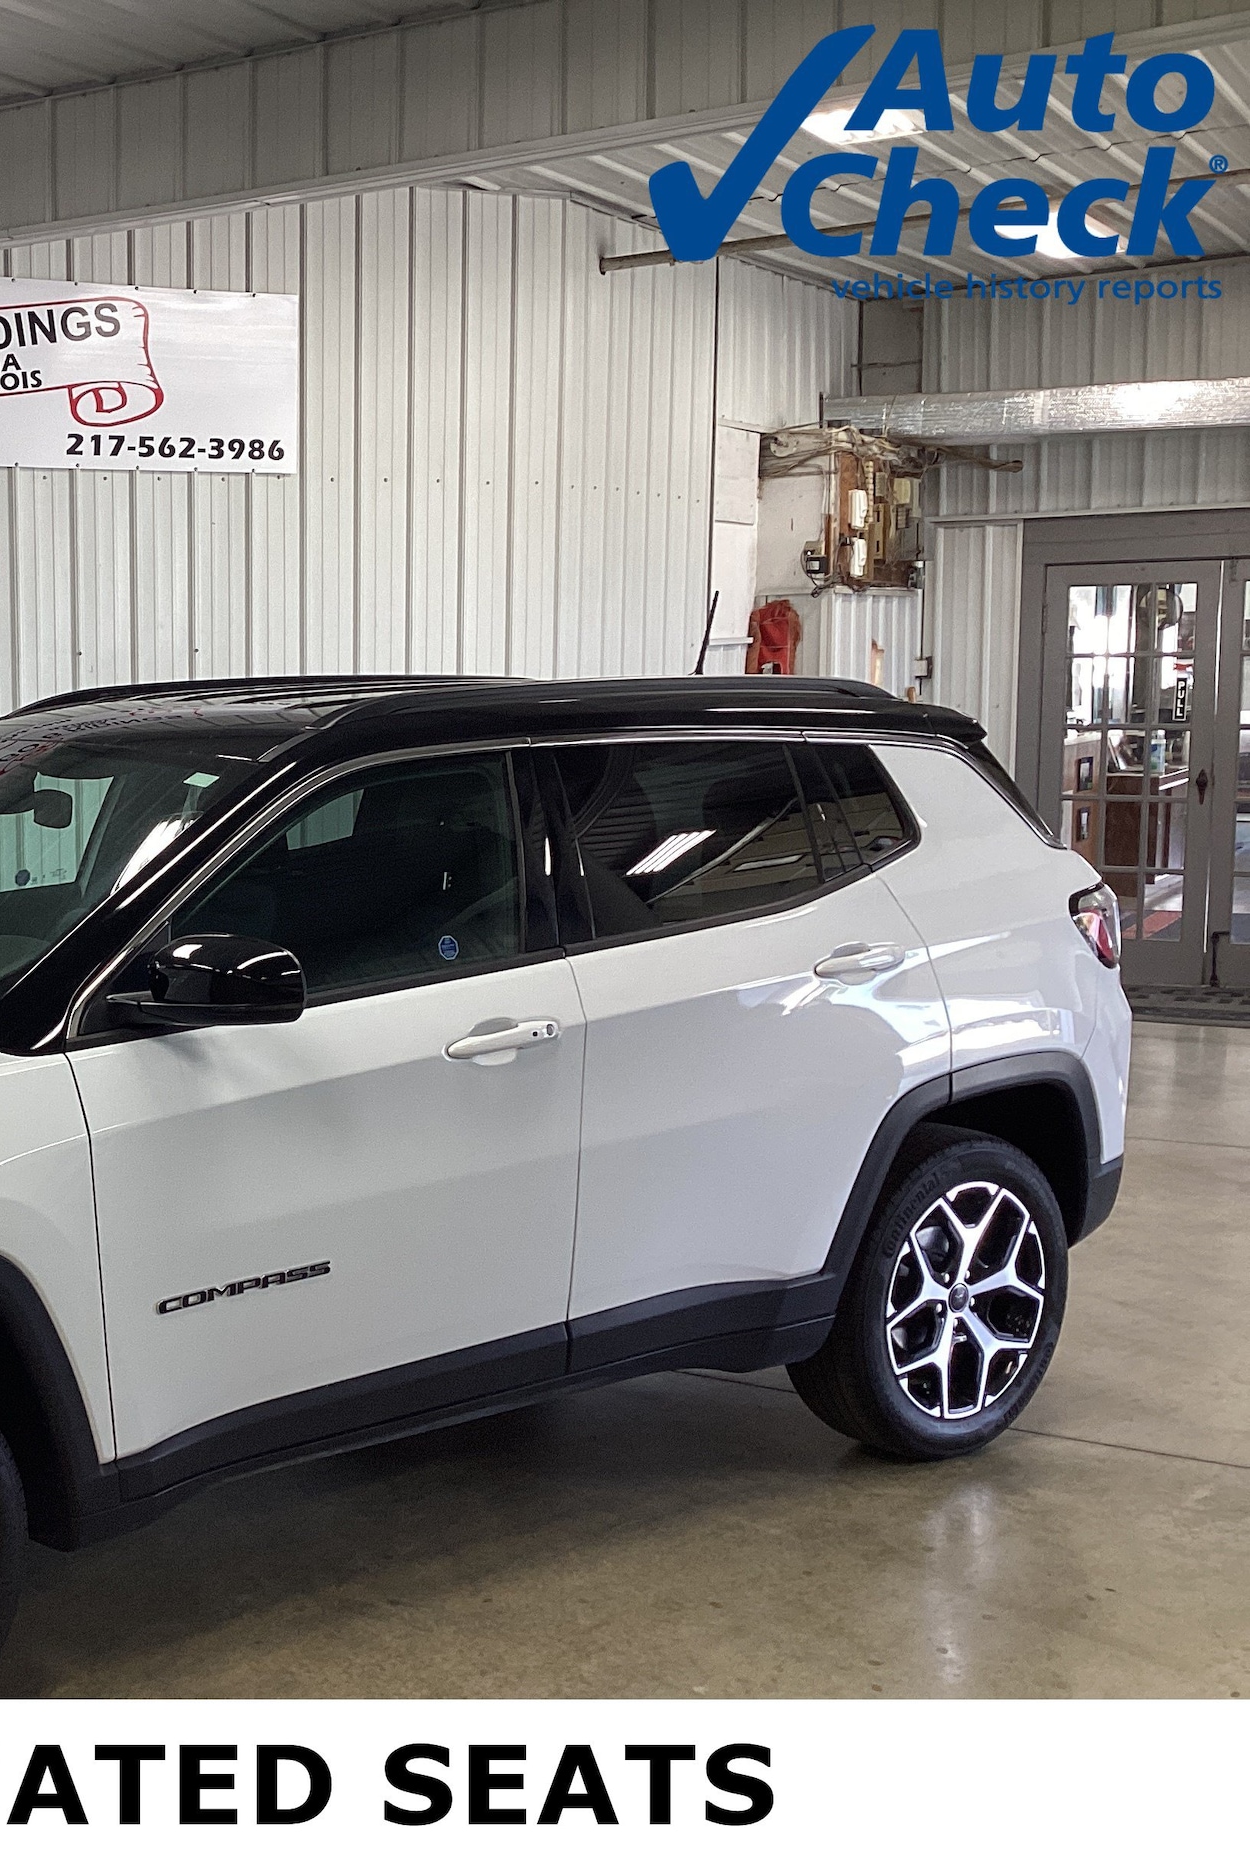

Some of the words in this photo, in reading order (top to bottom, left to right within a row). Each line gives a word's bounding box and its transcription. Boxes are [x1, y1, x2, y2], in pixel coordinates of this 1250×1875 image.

[65, 432, 286, 461] 217-562-3986
[1176, 681, 1186, 716] PULL
[155, 1259, 332, 1315] COMPASS
